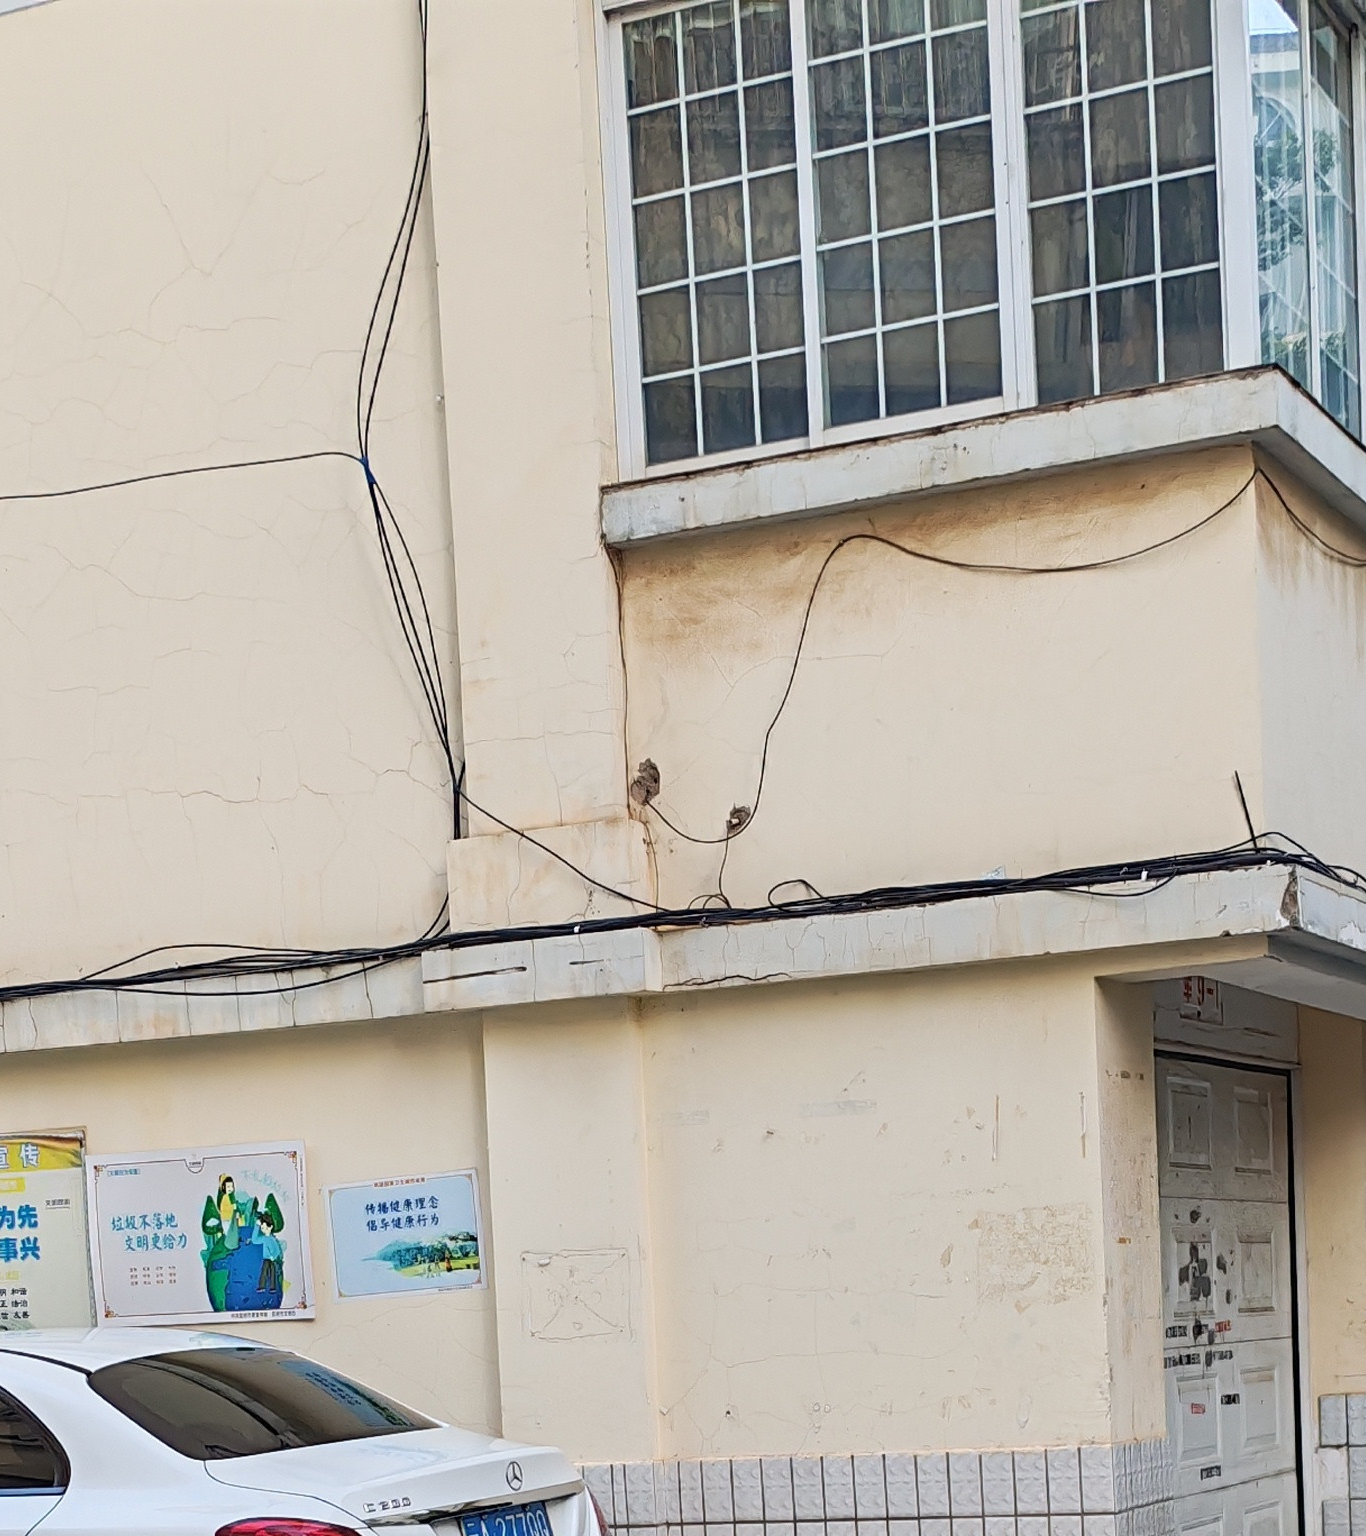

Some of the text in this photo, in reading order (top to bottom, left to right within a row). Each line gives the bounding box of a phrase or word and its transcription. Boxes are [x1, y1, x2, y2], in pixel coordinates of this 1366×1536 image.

[365, 1195, 439, 1216] 传播健康理念
[110, 1212, 178, 1232] 垃圾不落地
[366, 1213, 439, 1232] 倡导健康行为
[124, 1233, 188, 1252] 文明更给力
[362, 1497, 411, 1513] C 200
